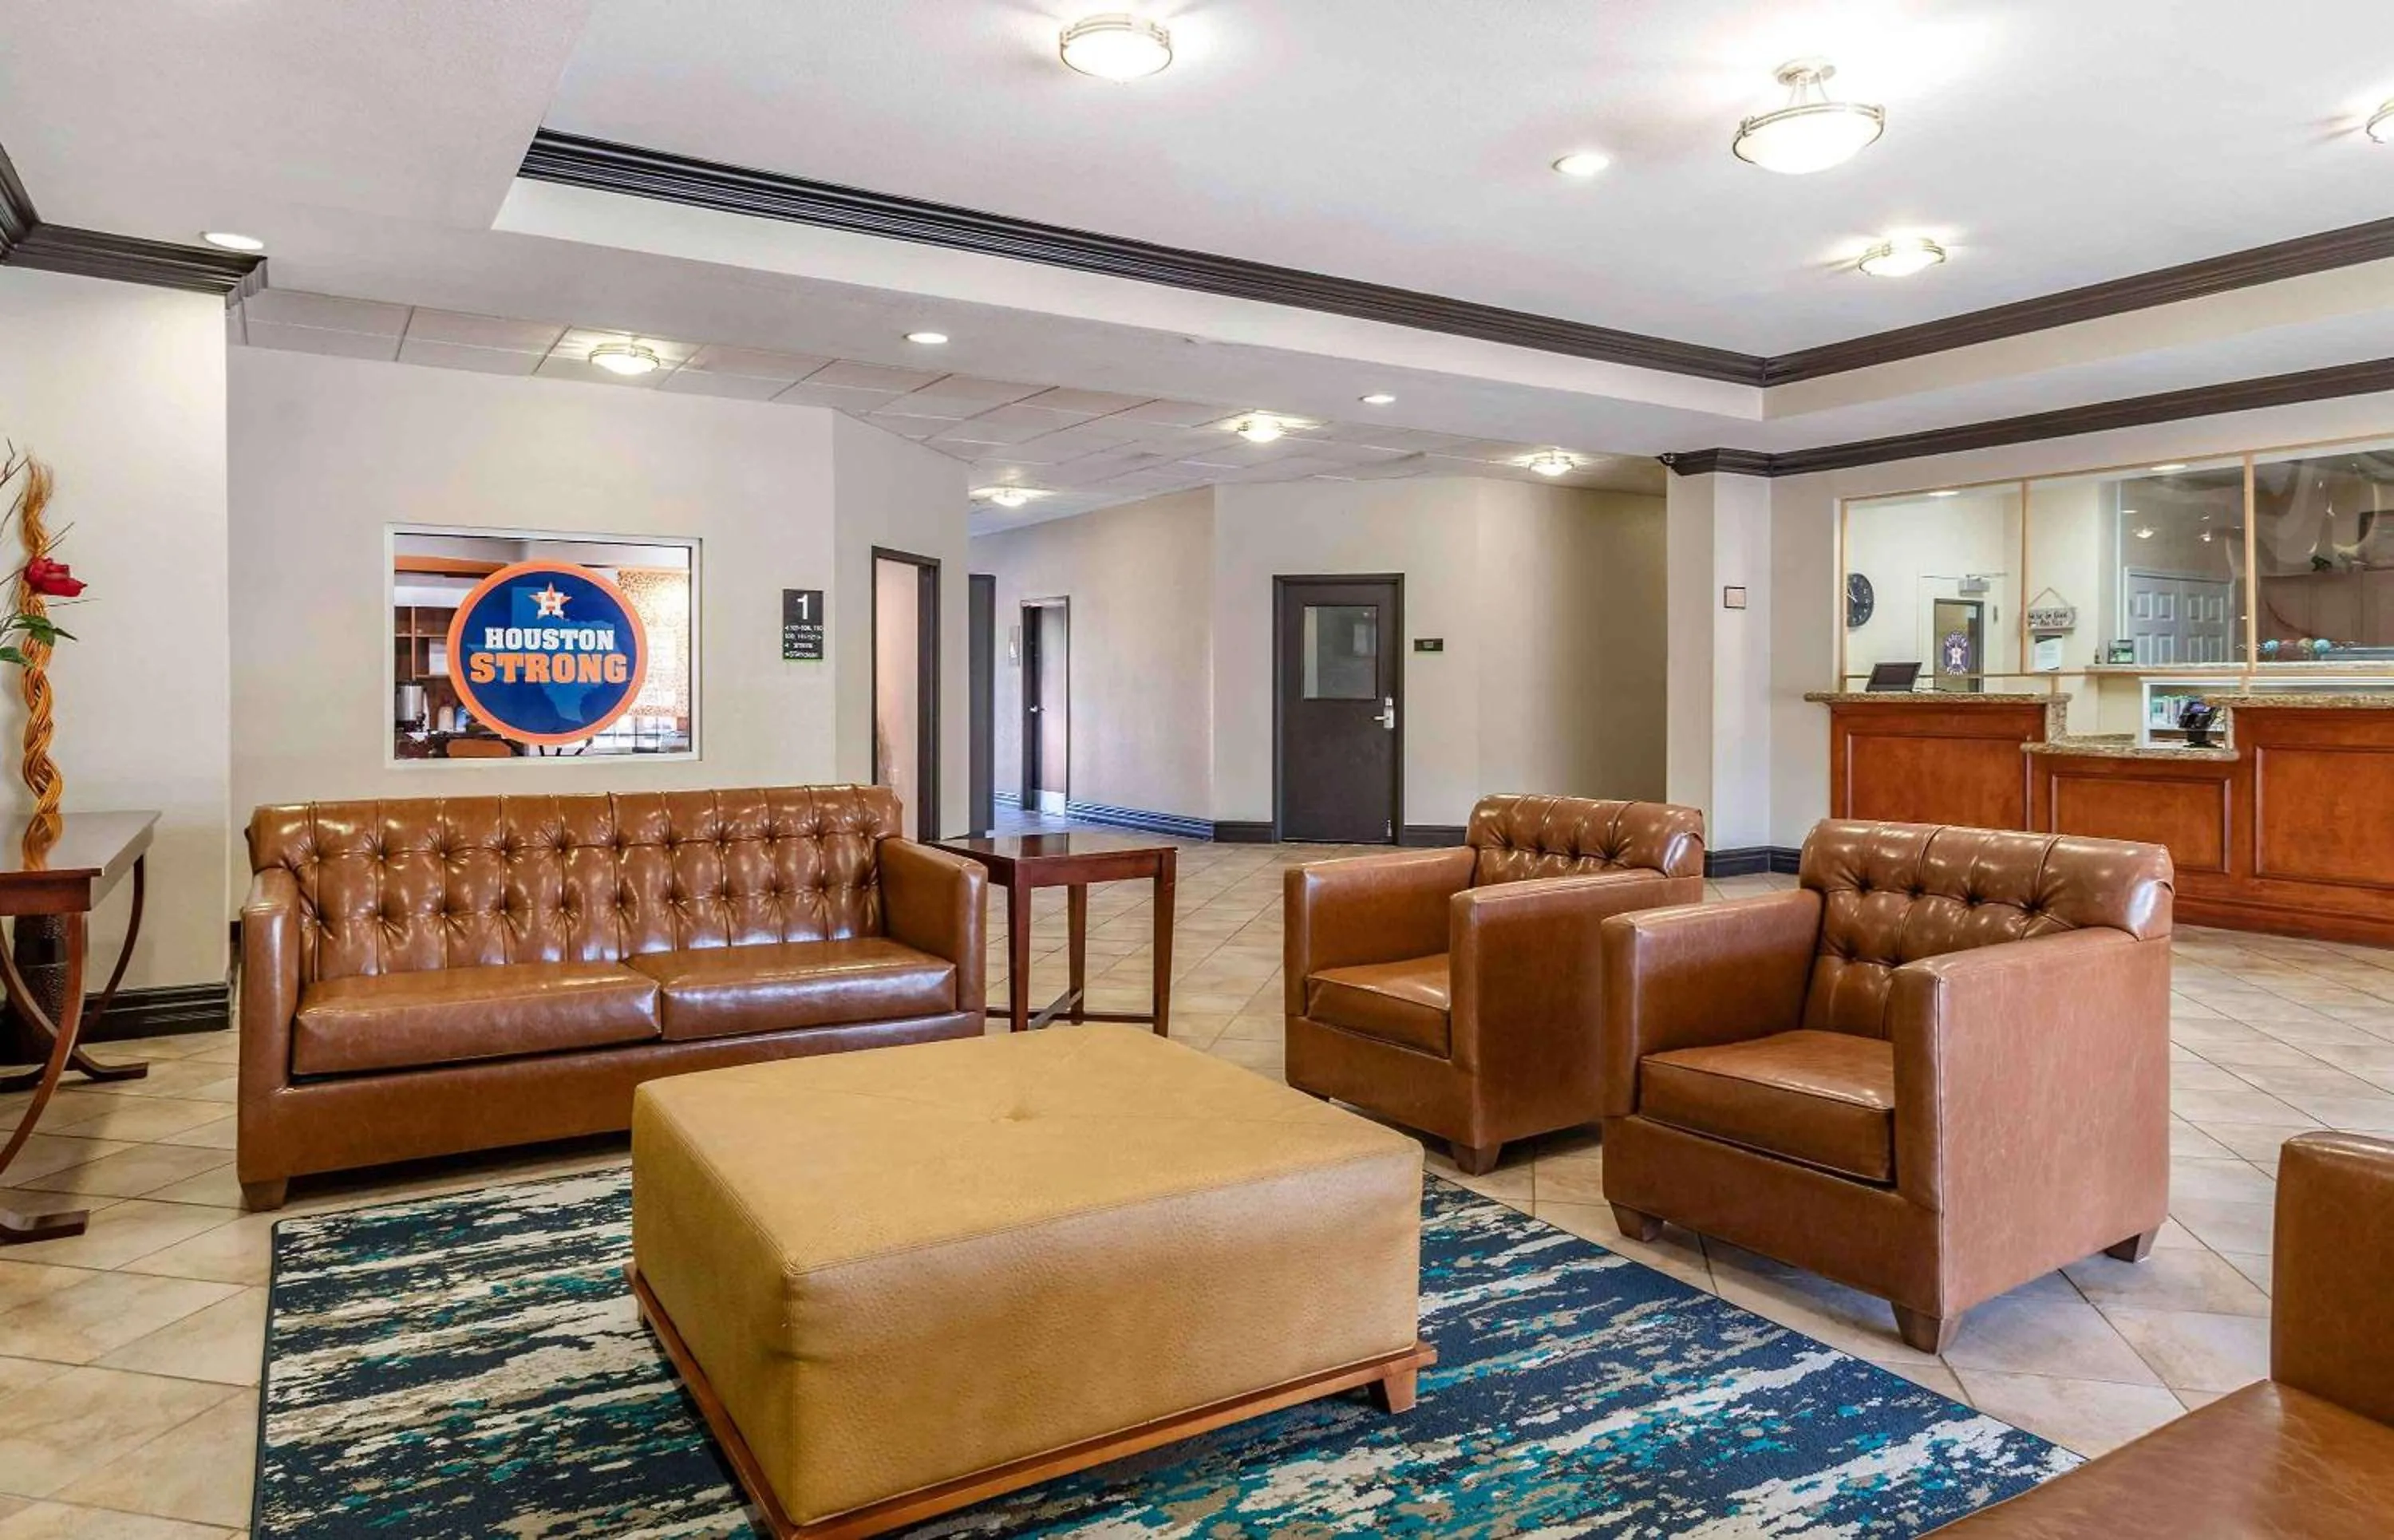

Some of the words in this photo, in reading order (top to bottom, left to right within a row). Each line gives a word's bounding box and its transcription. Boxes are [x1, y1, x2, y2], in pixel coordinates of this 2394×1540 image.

[796, 594, 808, 620] 1
[484, 627, 614, 650] HOUSTON
[470, 653, 627, 684] STRONG
